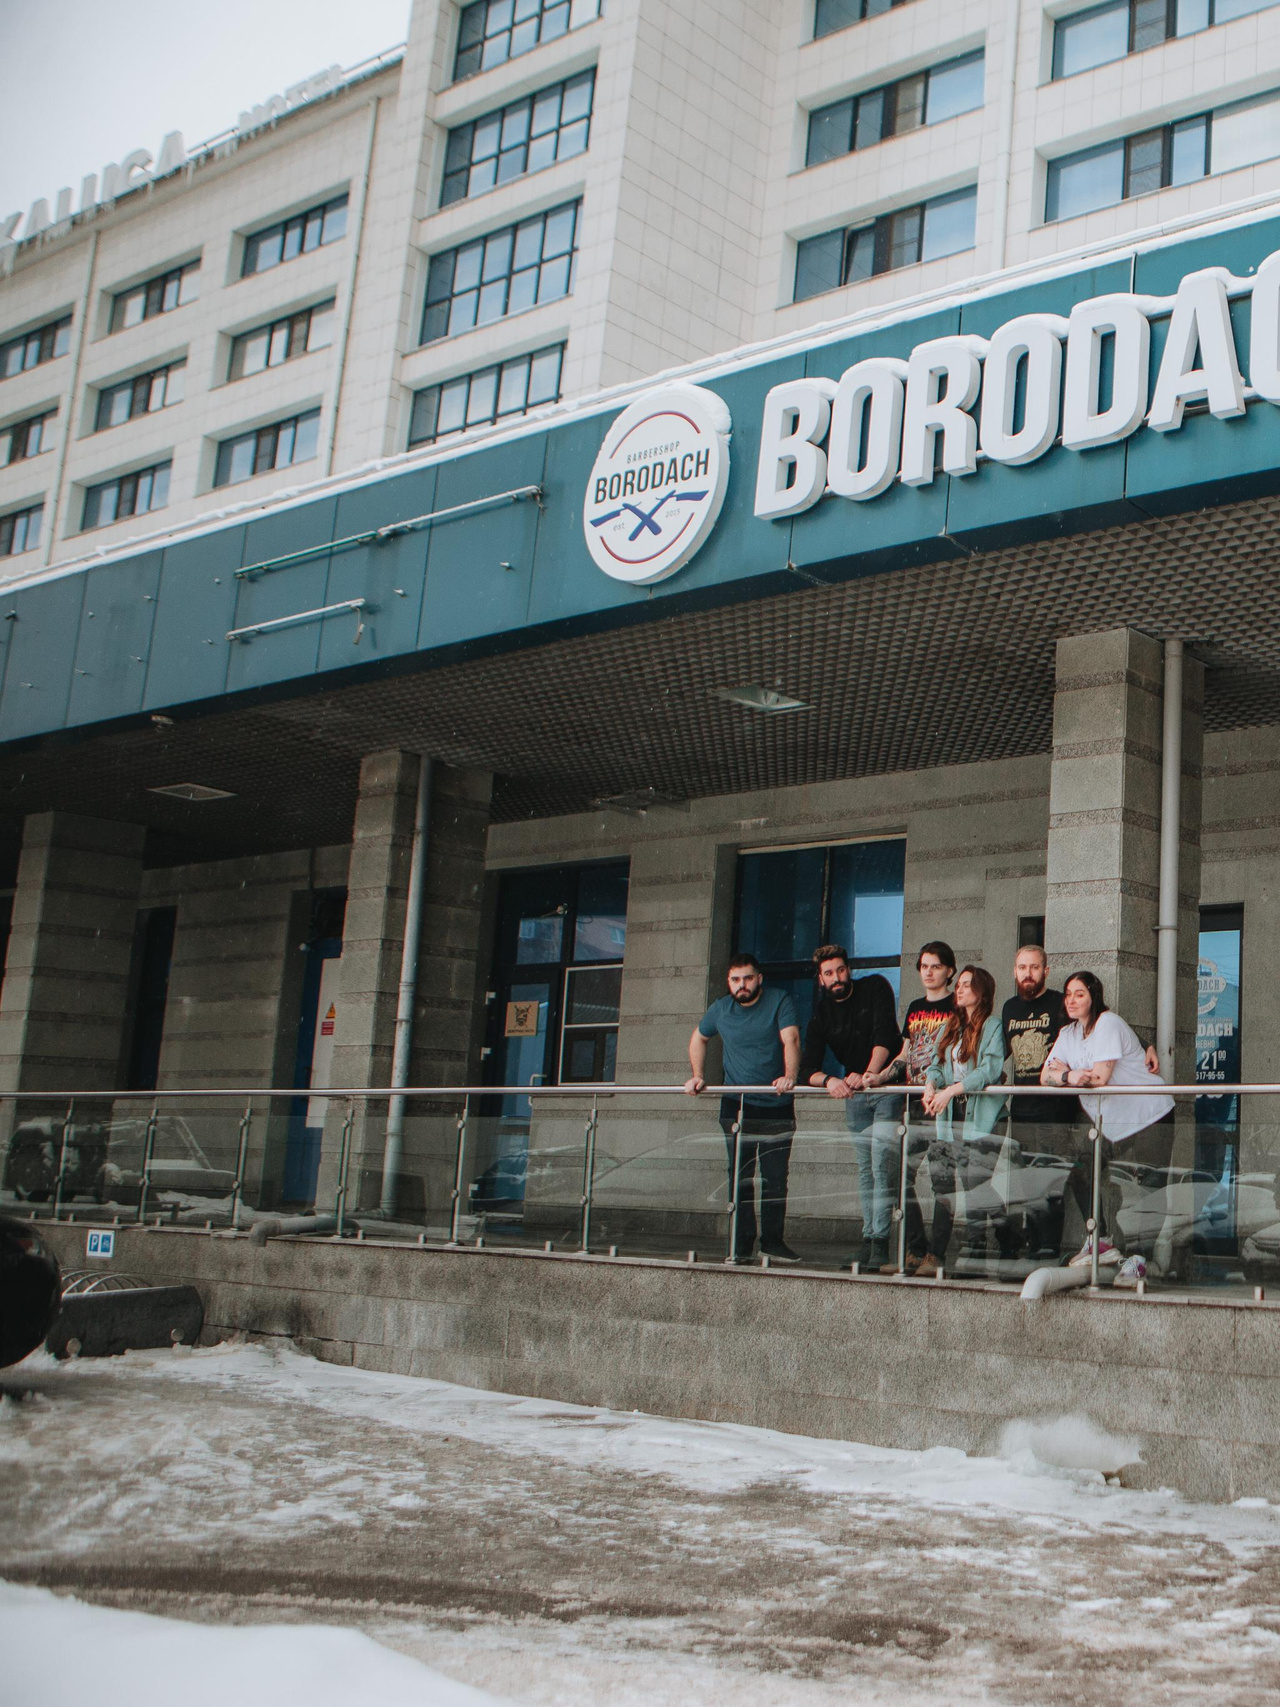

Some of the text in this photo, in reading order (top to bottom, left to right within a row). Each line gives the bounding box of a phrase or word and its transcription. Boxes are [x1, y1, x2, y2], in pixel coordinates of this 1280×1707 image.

[626, 441, 681, 464] BARBERSHOP
[594, 448, 710, 504] BORODACH
[1198, 979, 1220, 991] DACH
[1197, 1023, 1233, 1037] DACH
